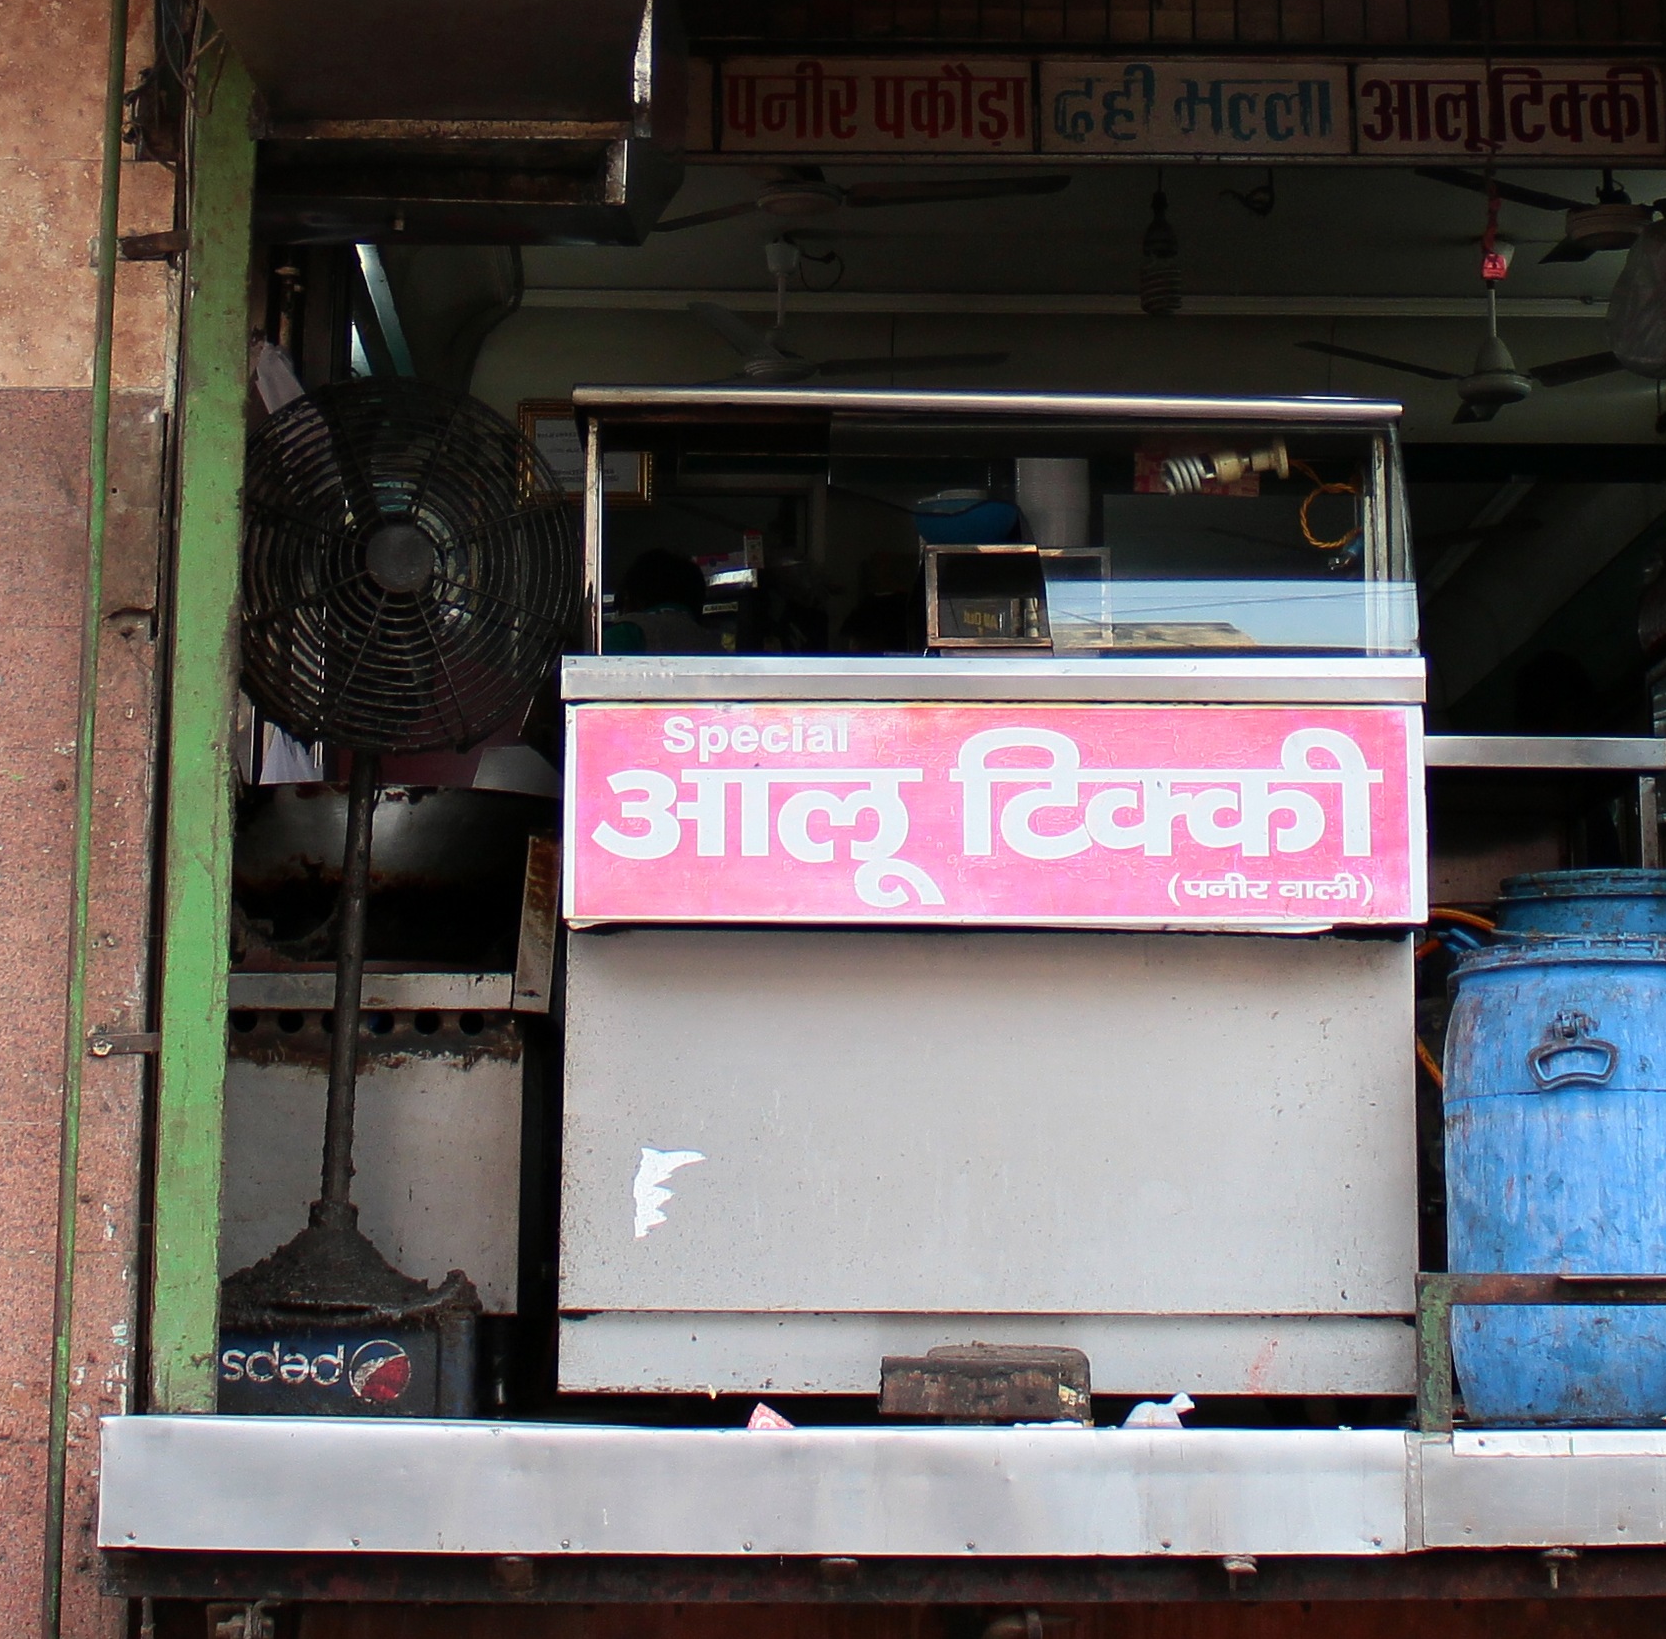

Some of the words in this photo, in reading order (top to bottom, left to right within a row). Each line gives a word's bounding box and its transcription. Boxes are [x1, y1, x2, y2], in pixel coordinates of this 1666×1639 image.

[721, 61, 858, 140] पनीर
[1360, 76, 1497, 154] आलू
[1489, 66, 1660, 145] टिक्की
[663, 716, 850, 763] Special
[592, 768, 945, 906] आलू
[948, 727, 1383, 858] टिक्की
[1166, 872, 1268, 905] (पनीर
[1277, 872, 1376, 905] वाली)
[222, 1341, 345, 1385] peps
